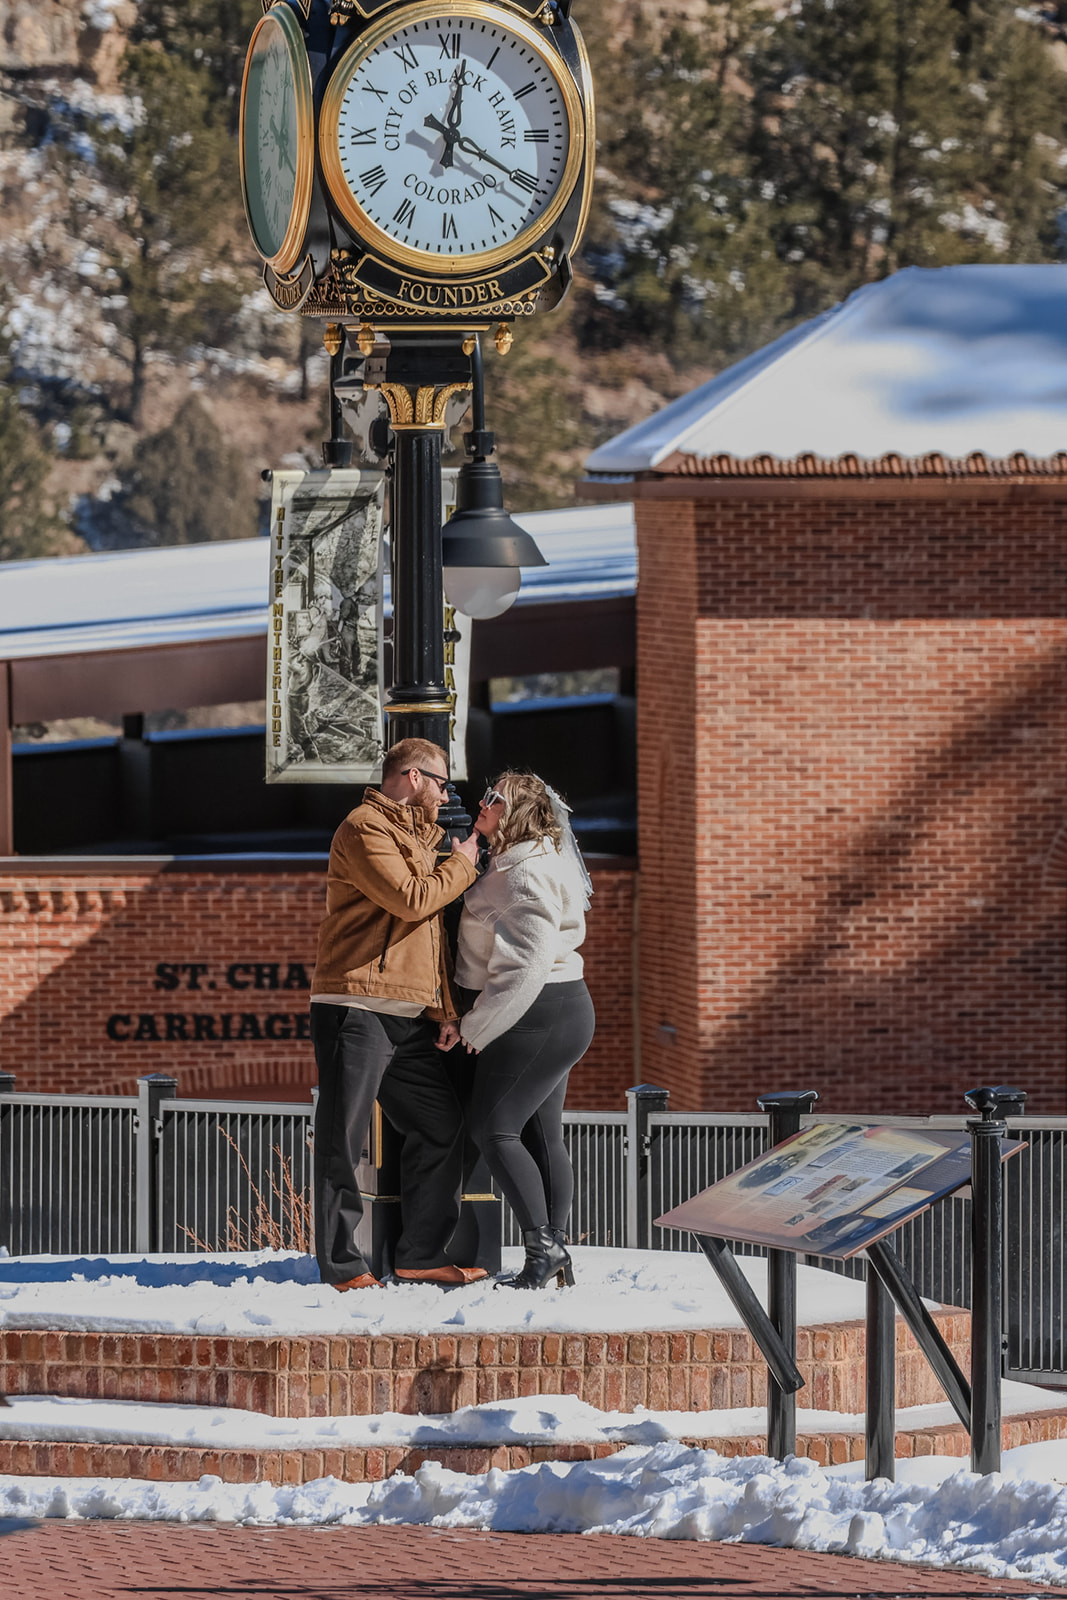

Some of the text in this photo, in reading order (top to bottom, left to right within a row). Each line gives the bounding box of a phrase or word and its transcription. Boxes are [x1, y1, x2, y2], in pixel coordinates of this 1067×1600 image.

[393, 43, 419, 74] XI
[438, 33, 460, 59] XII
[361, 79, 388, 103] X
[513, 81, 537, 100] II
[384, 68, 516, 151] CITY OF BLACK HAWK
[351, 126, 376, 145] IX
[524, 129, 549, 143] III
[359, 164, 388, 198] VIII
[403, 173, 496, 205] COLORADO
[397, 279, 504, 307] FOUNDER
[271, 507, 286, 747] HIT THE MOTHERLODE
[155, 963, 216, 990] ST.
